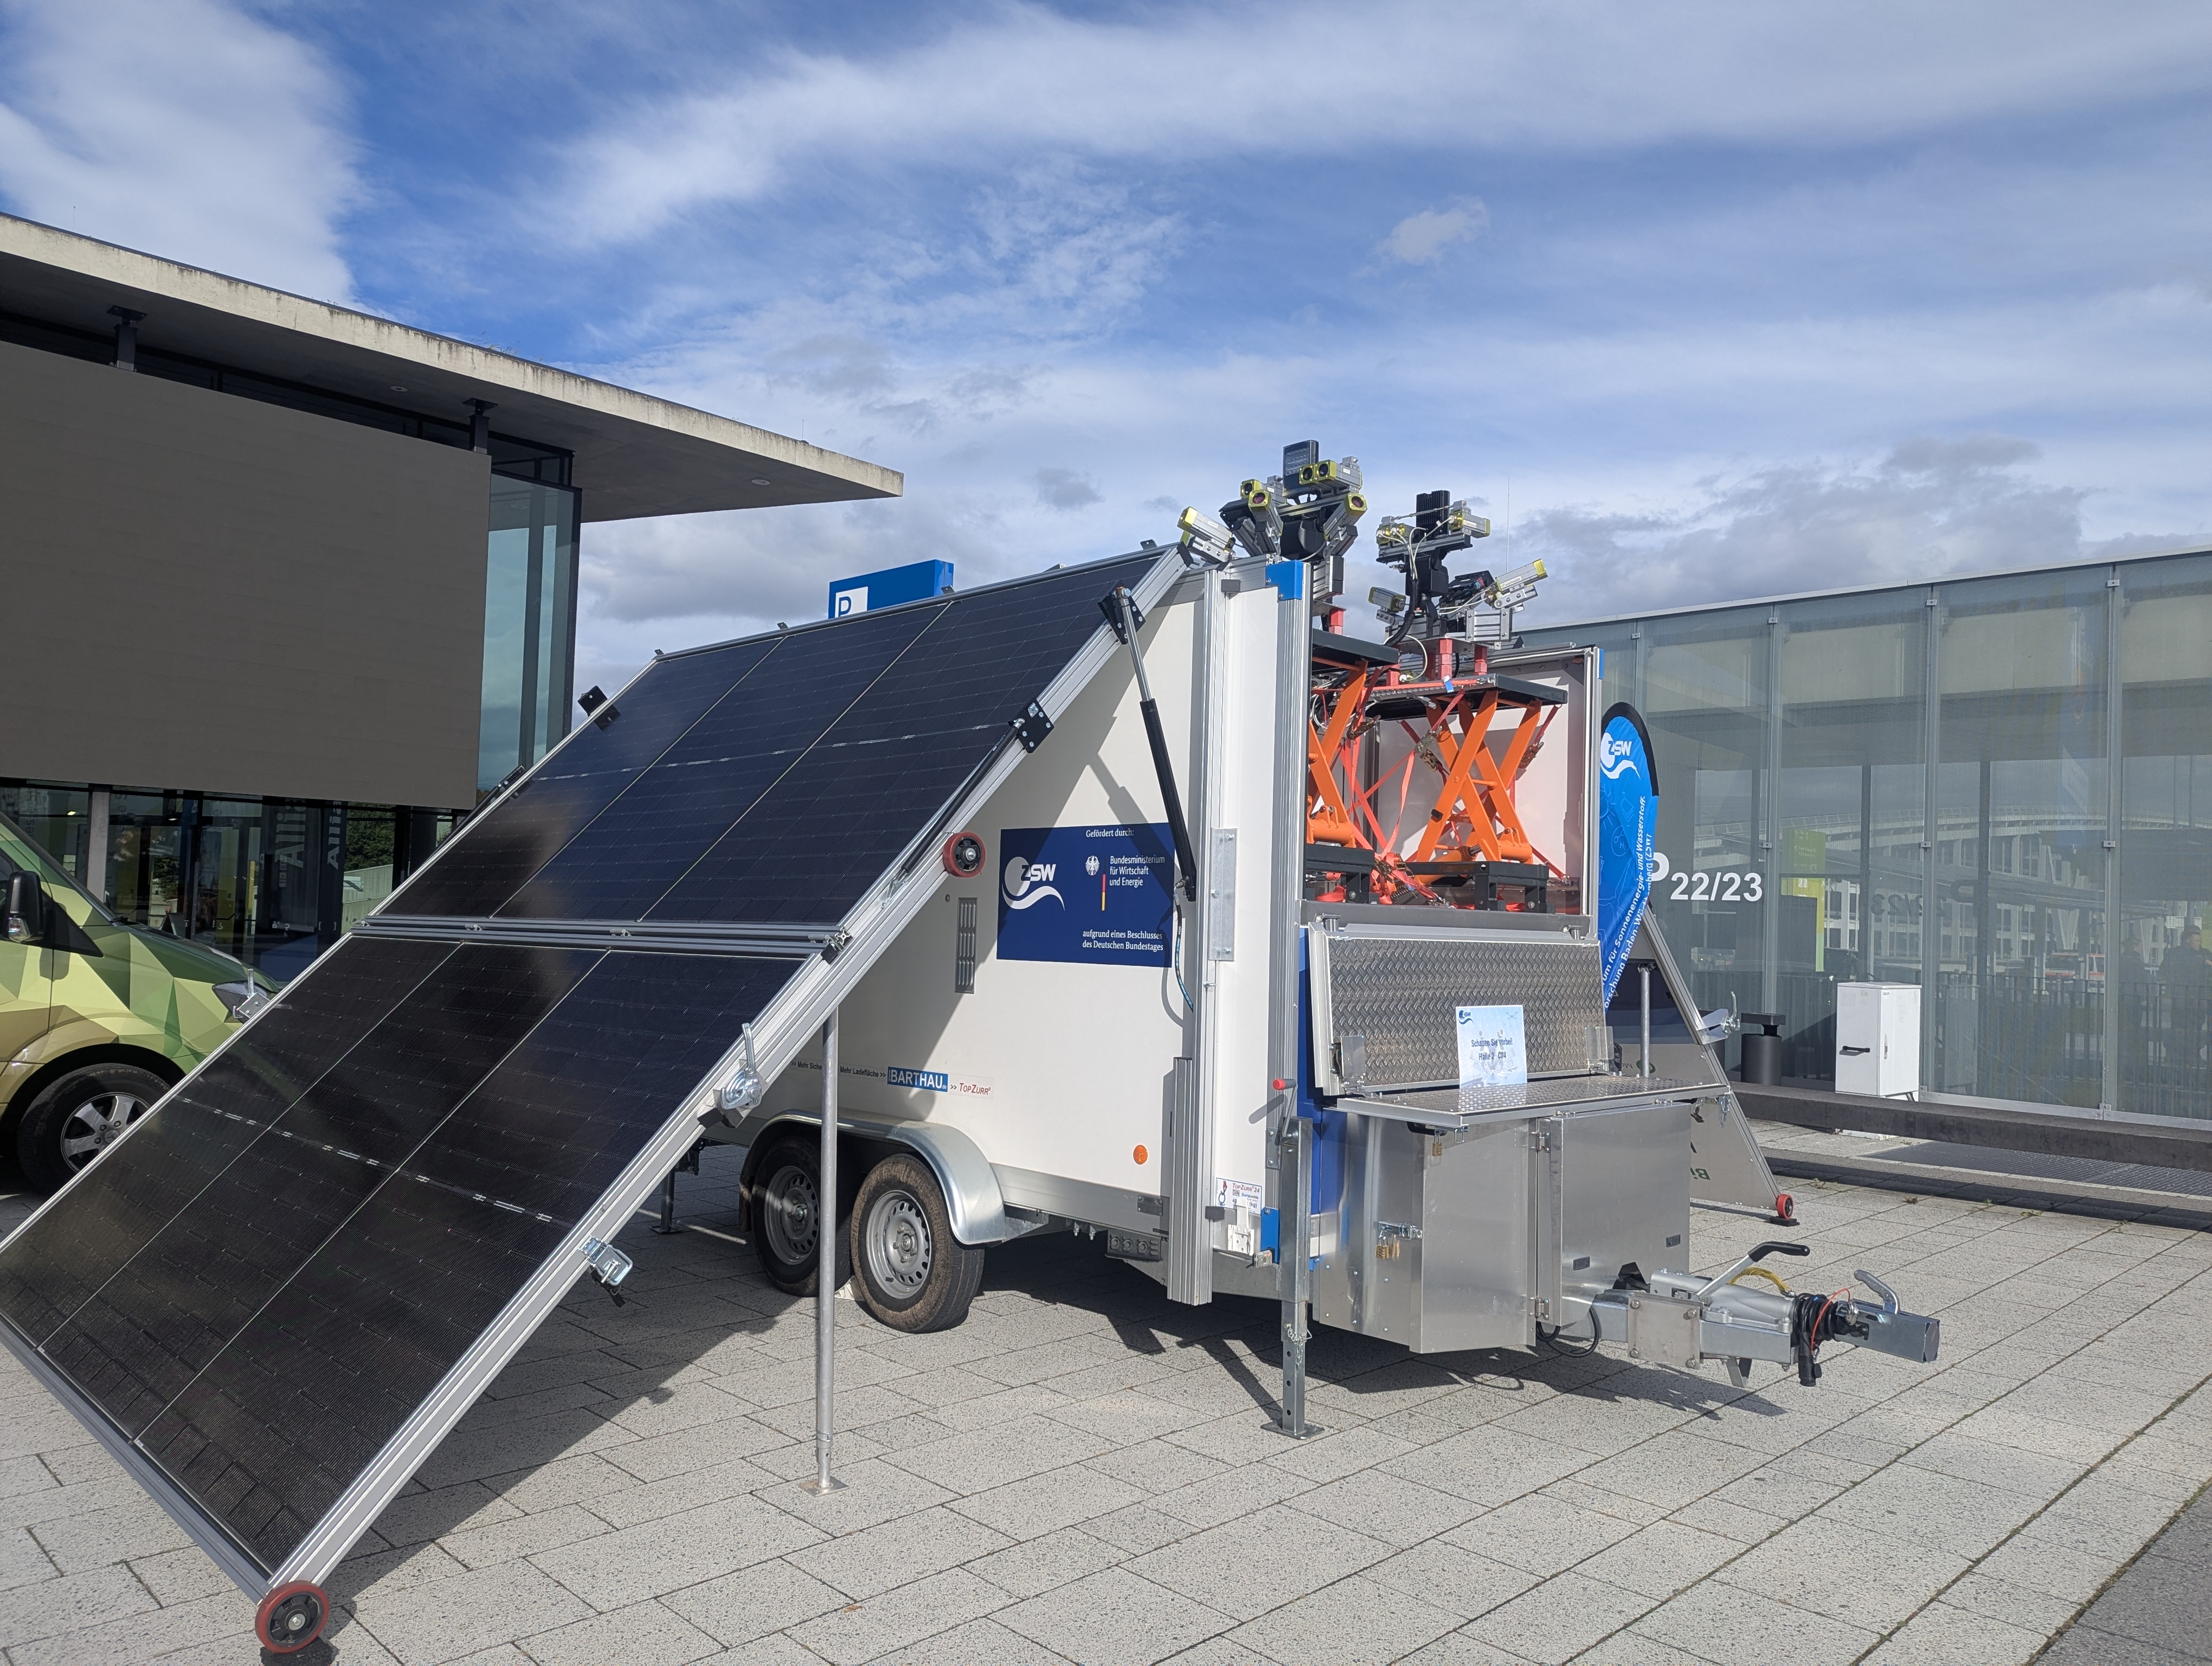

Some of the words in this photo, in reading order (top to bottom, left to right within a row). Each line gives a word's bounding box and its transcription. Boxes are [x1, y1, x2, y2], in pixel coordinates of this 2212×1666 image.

[839, 596, 852, 617] P
[1608, 740, 1632, 757] ZSW
[327, 801, 342, 870] Allia
[1086, 829, 1114, 837] Gefördert
[1115, 828, 1134, 836] durch:
[1110, 854, 1165, 864] Bundesministerium
[1021, 863, 1056, 881] ZSW
[1110, 866, 1118, 875] für
[1119, 866, 1149, 875] Wirtschaft
[1109, 877, 1121, 886] und
[1122, 876, 1143, 888] Energie
[1608, 948, 1618, 964] für
[1614, 872, 1645, 948] Sonnenenergie-
[1636, 796, 1647, 851] Wasserstoff-
[1670, 872, 1763, 902] 22/23
[1082, 929, 1110, 939] aufgrund
[1110, 930, 1126, 938] eines
[1127, 930, 1162, 939] Beschlusses
[1082, 940, 1092, 948] des
[1093, 940, 1124, 949] Deutschen
[1126, 941, 1163, 952] Bundestages
[1604, 963, 1626, 1009] orschung
[1471, 1039, 1490, 1047] Schauen
[1478, 1052, 1491, 1060] Halle
[1491, 1052, 1495, 1060] 2
[840, 1066, 852, 1074] Mehr
[853, 1067, 879, 1078] Ladefläche
